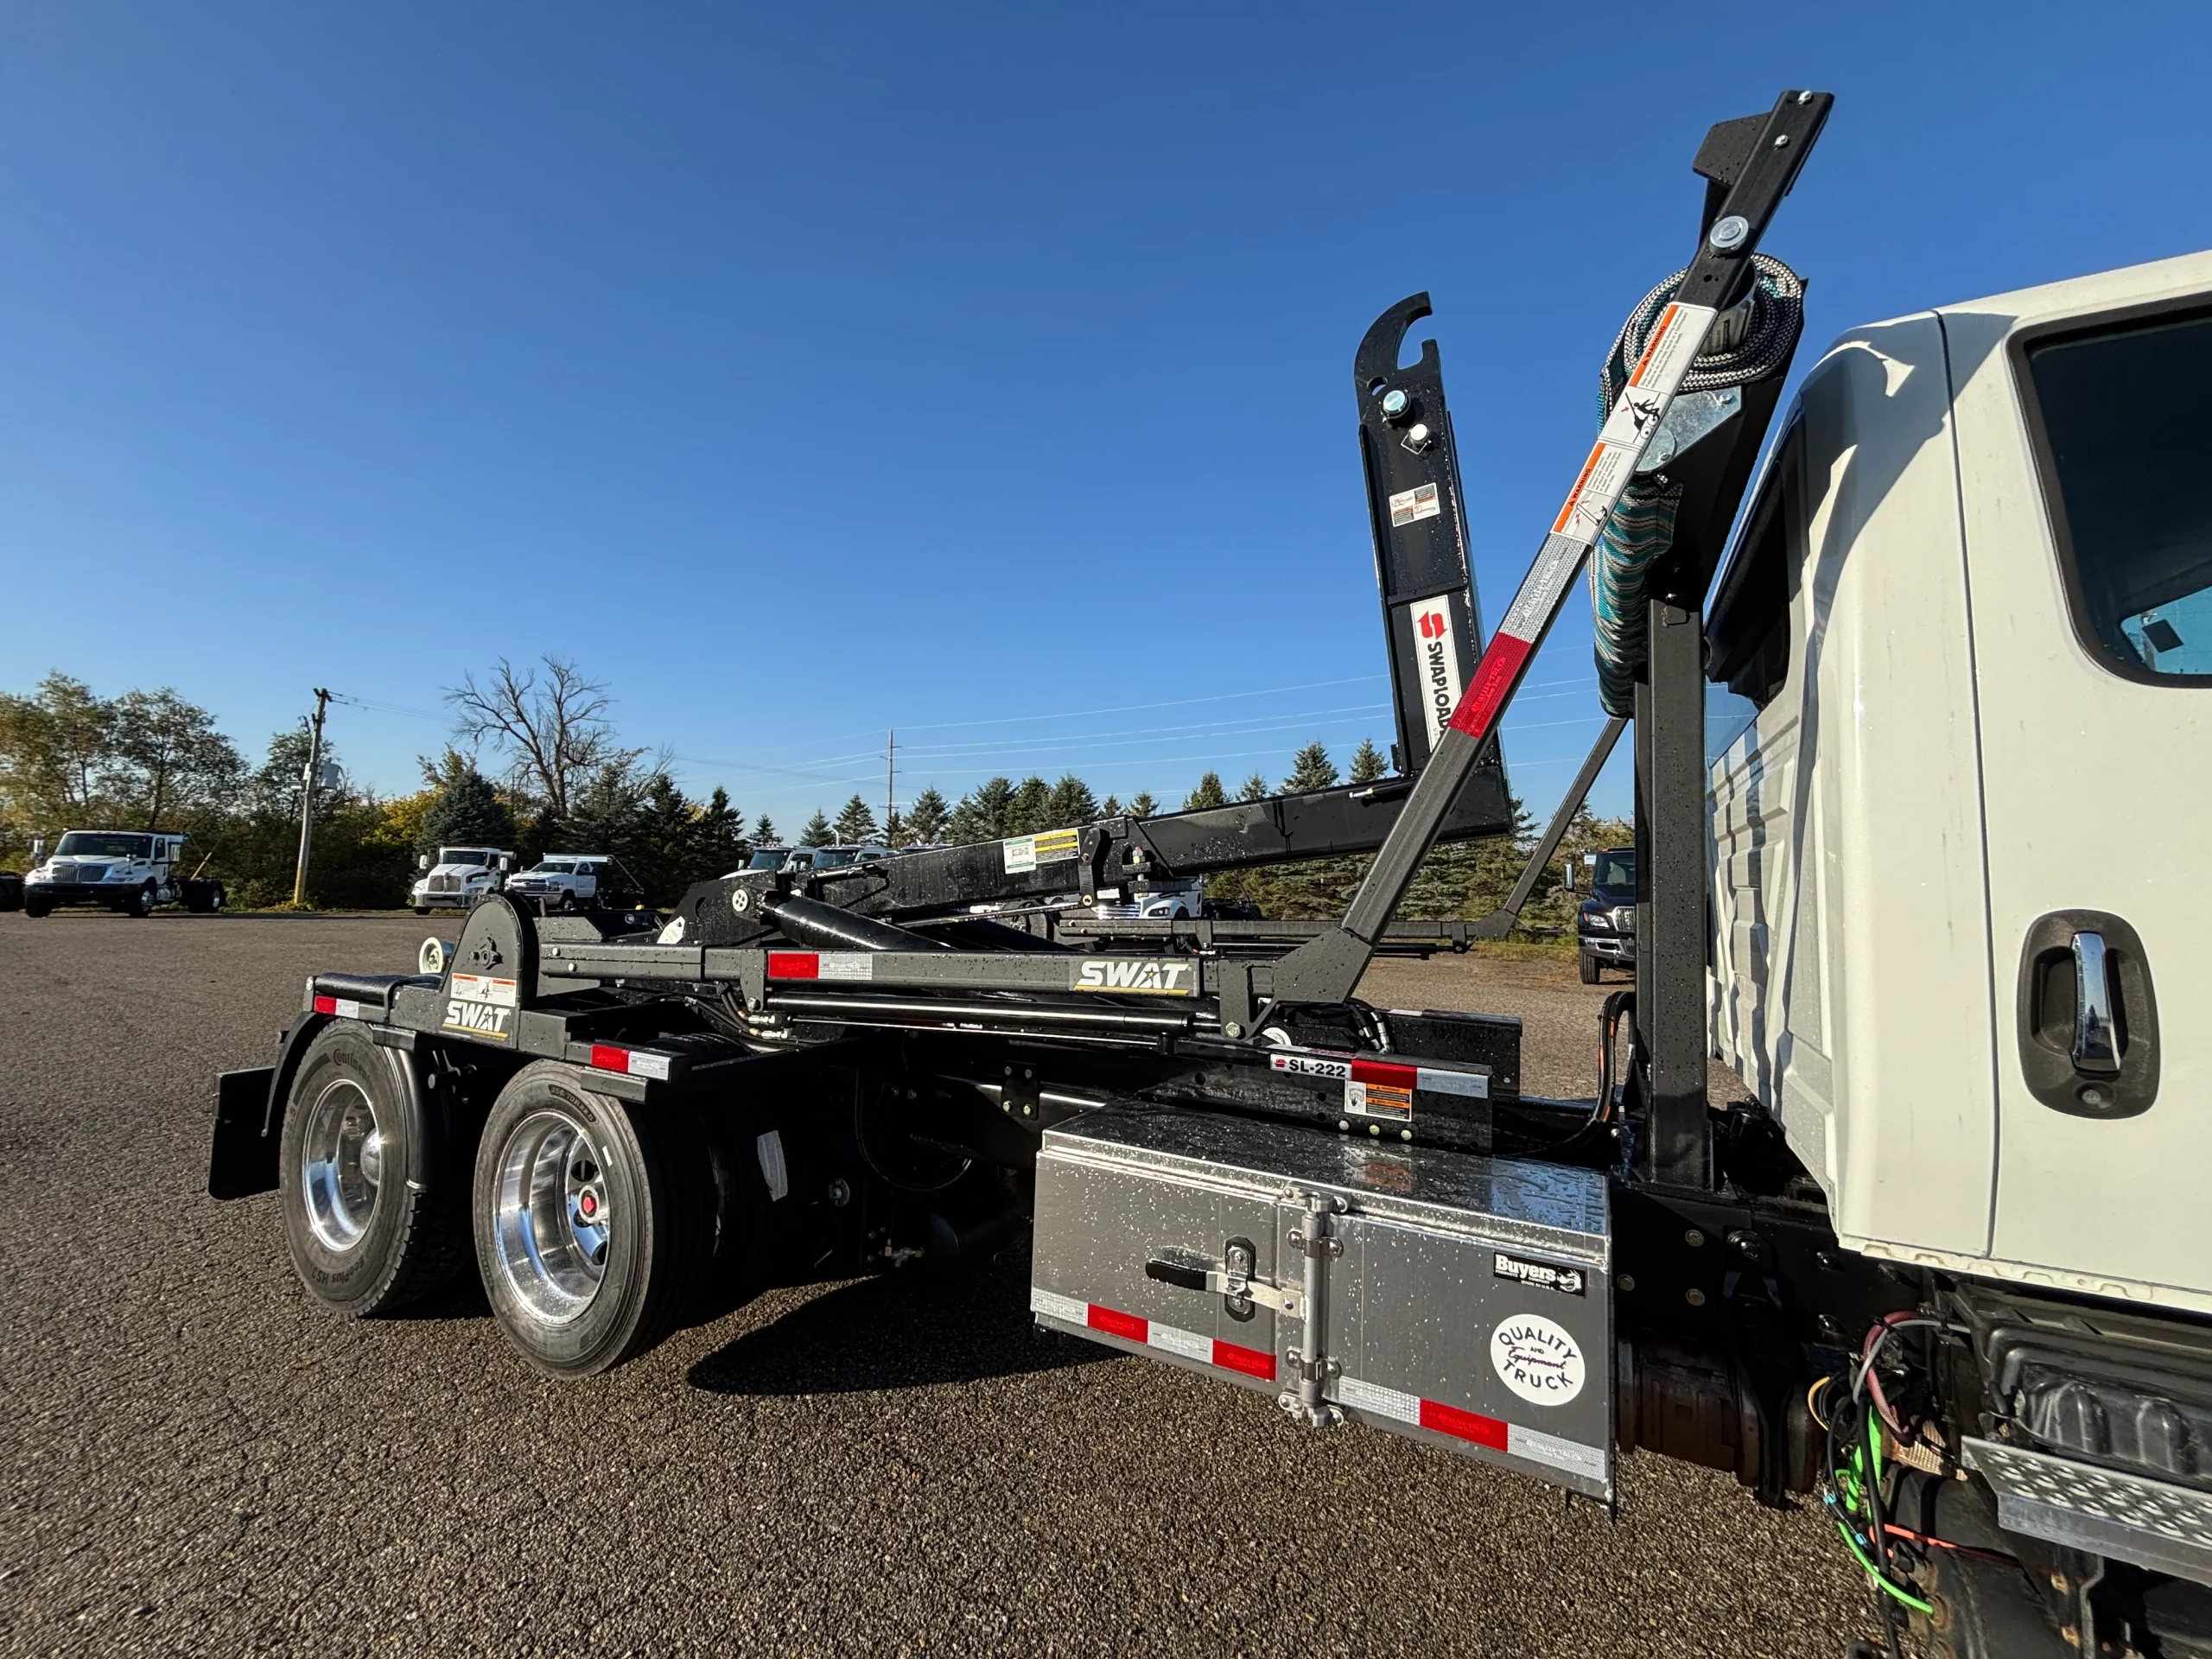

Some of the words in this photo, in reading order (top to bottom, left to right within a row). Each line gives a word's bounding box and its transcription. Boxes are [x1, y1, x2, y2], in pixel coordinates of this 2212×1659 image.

[1647, 326, 1666, 357] WARNING
[1572, 468, 1591, 499] WARNING
[1077, 960, 1189, 989] SWAT
[443, 1001, 510, 1033] SWAT
[334, 1048, 373, 1090] Continent
[1289, 1058, 1345, 1078] SL-222
[1496, 1254, 1556, 1282] Buyers
[1498, 1326, 1577, 1359] QUALITY
[1509, 1346, 1567, 1370] Equipment
[1503, 1359, 1573, 1390] TRUCK
